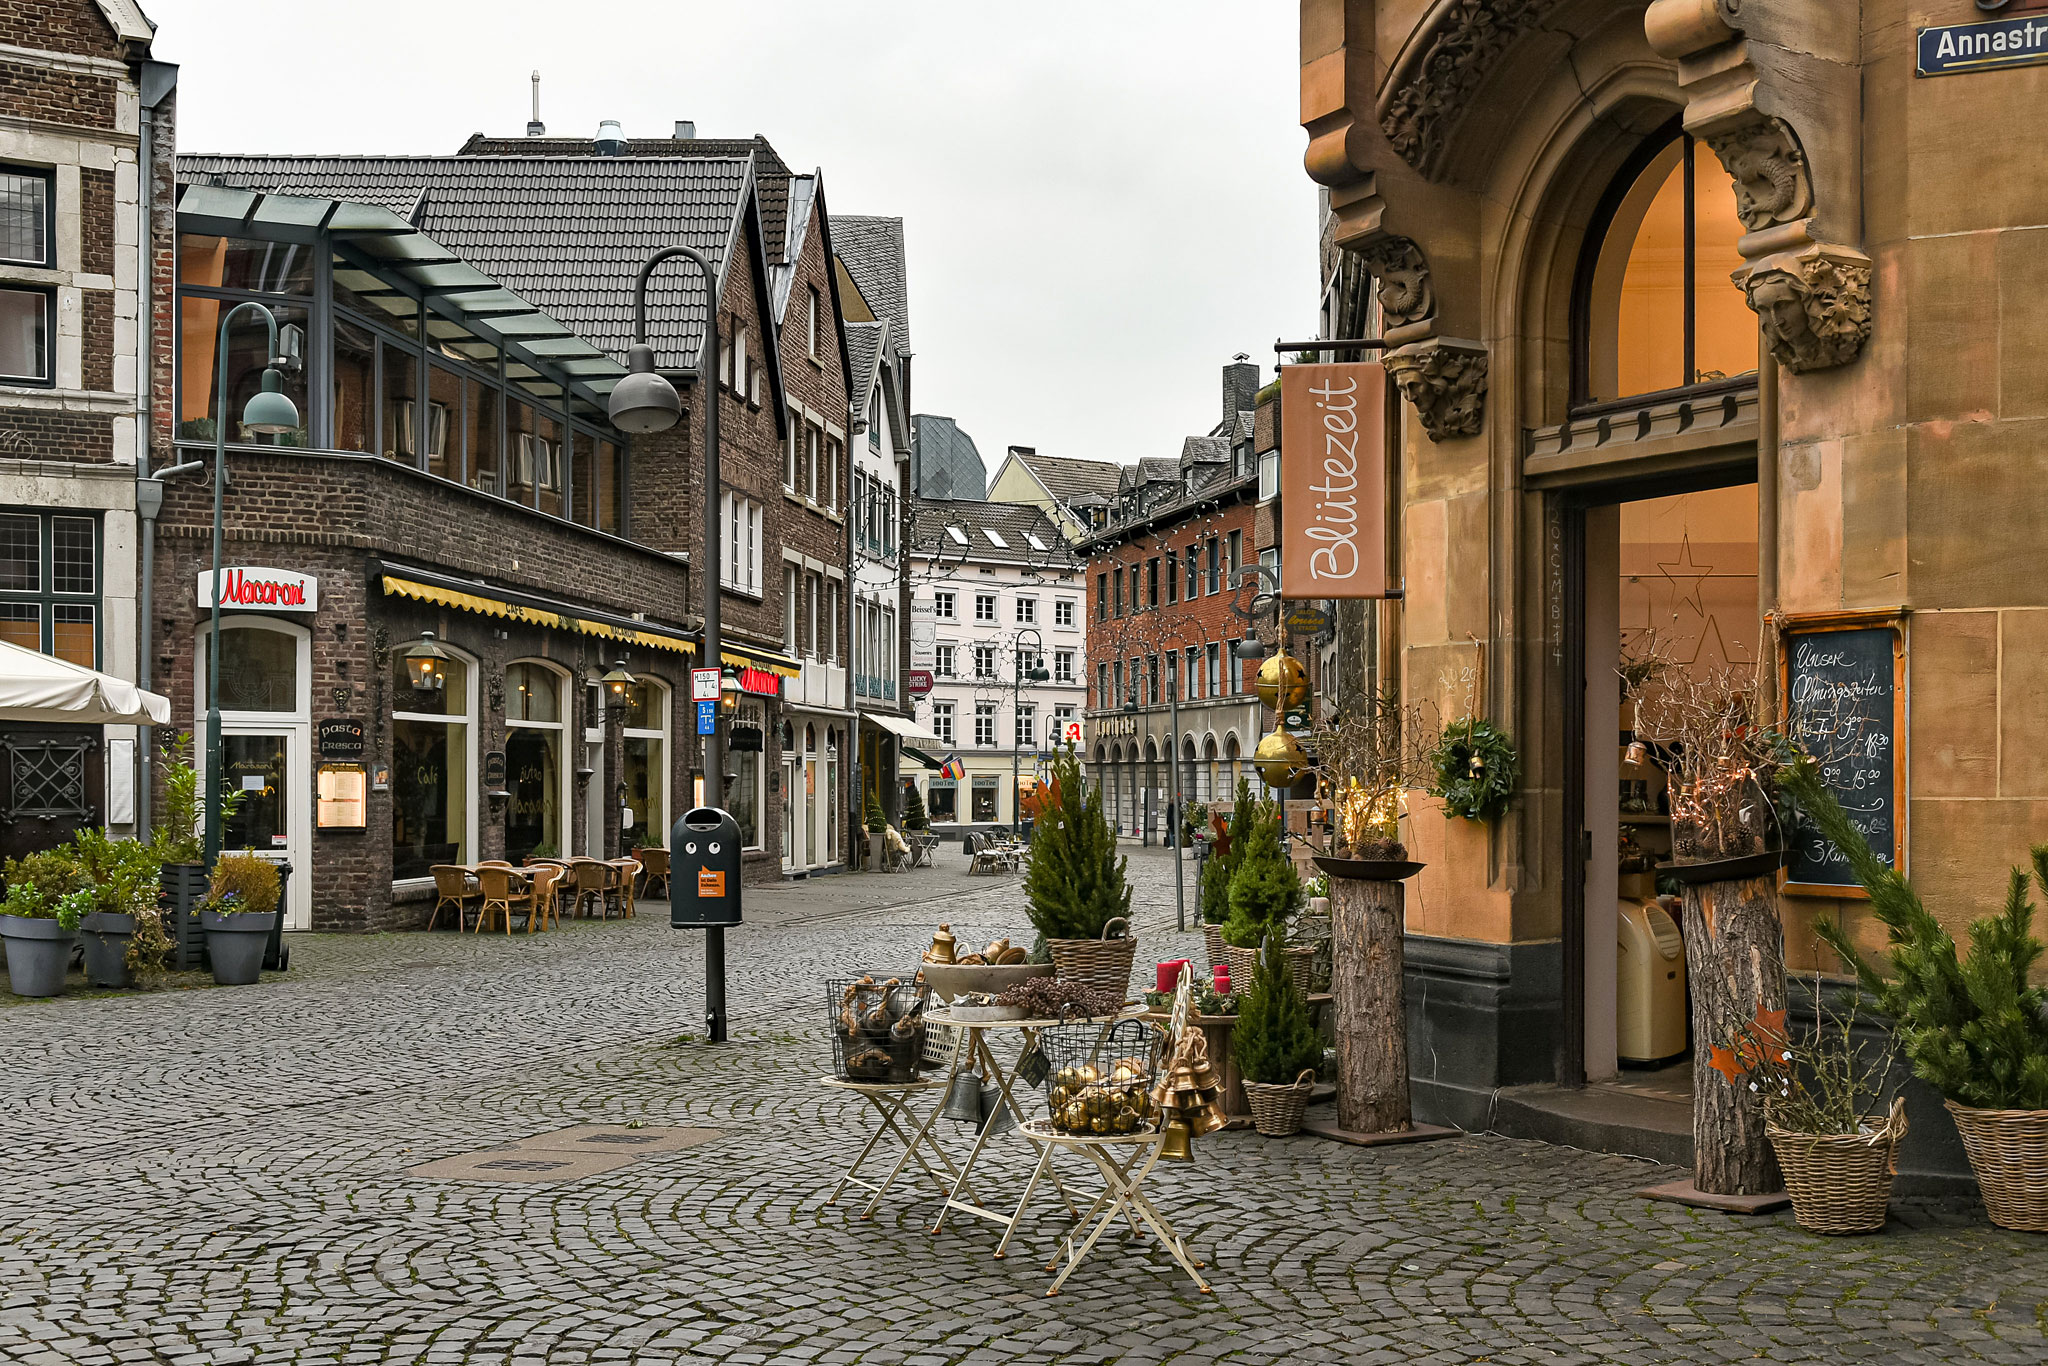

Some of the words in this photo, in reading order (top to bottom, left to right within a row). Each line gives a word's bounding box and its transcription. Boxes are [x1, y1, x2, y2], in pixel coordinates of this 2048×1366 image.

[1304, 376, 1359, 581] Blütezeit
[219, 568, 306, 606] Macaroni
[911, 605, 936, 613] Beissel's
[321, 724, 361, 738] pasta
[1095, 716, 1138, 738] Apotheke
